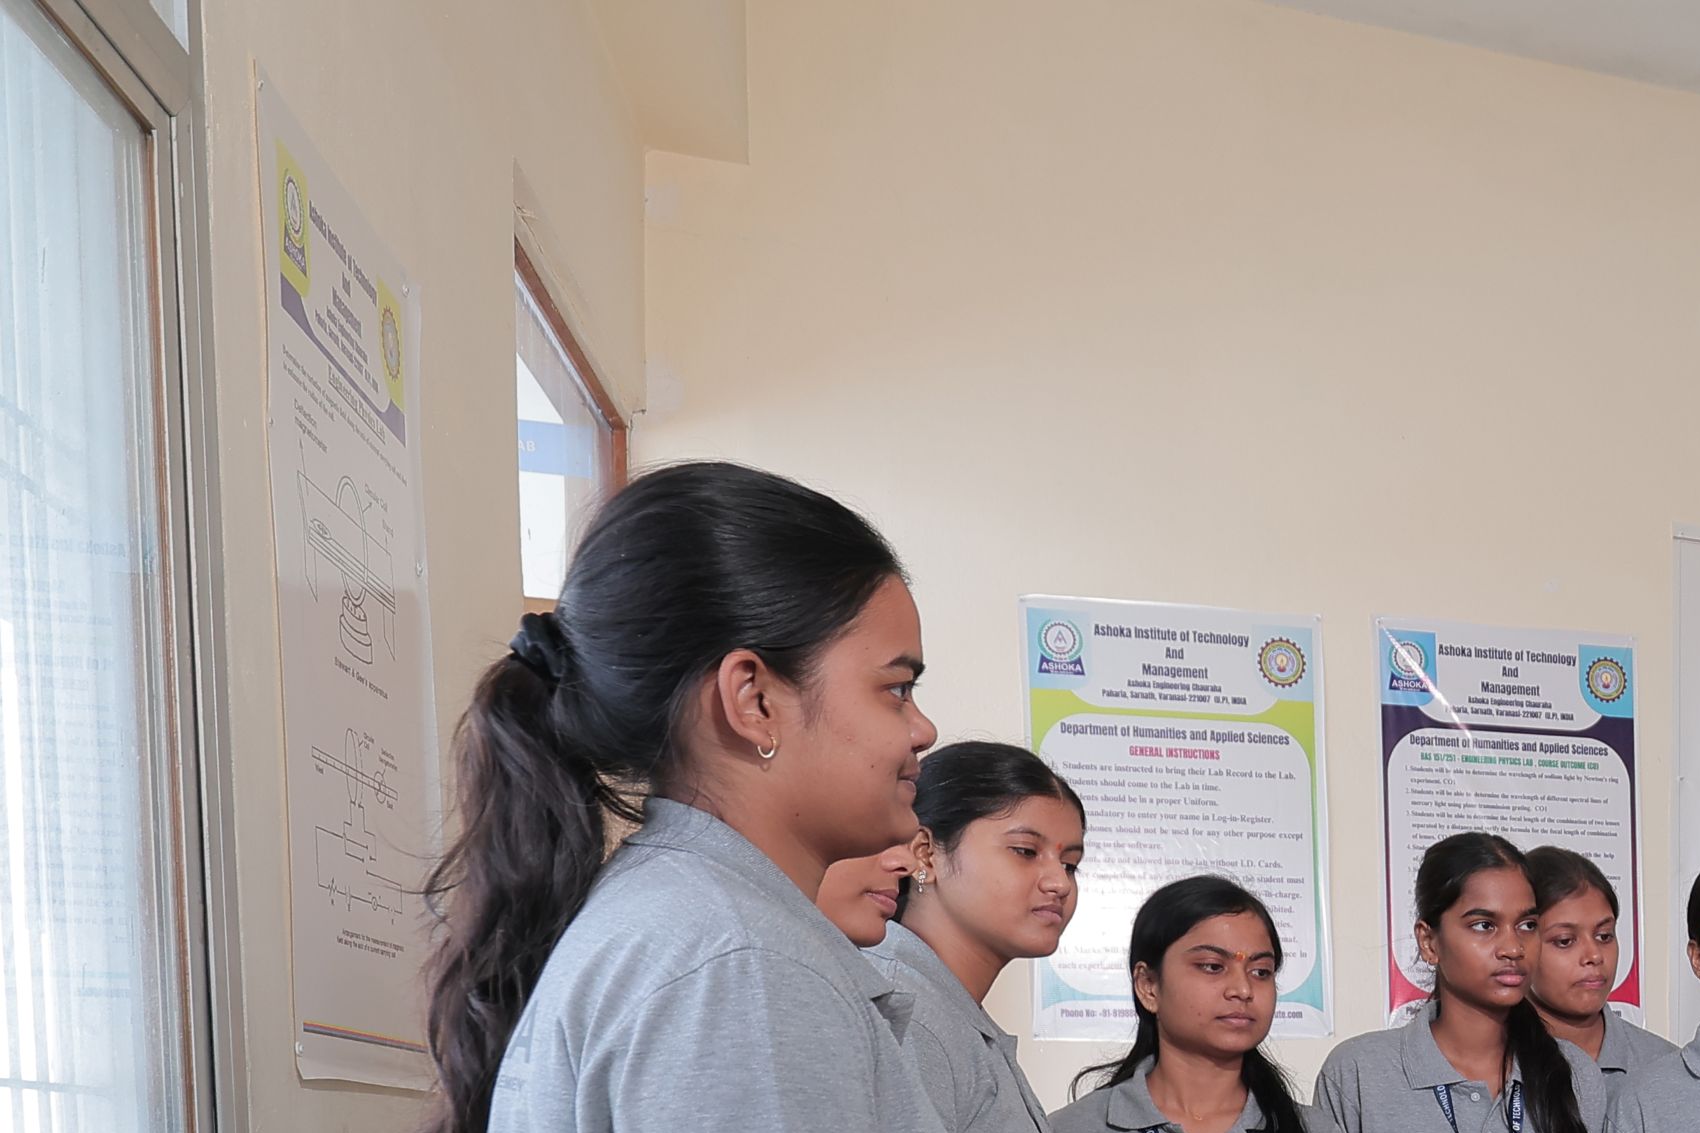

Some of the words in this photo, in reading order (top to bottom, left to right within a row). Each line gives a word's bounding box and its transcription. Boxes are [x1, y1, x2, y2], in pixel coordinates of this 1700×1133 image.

[1093, 623, 1132, 638] Ashoka
[1133, 626, 1177, 641] Institute
[1179, 629, 1190, 642] of
[1191, 630, 1249, 647] Technology
[1164, 646, 1184, 660] And
[1437, 643, 1472, 657] Ashoka
[1473, 646, 1512, 660] Institute
[1514, 649, 1524, 661] of
[1525, 650, 1577, 666] Technology
[1041, 661, 1082, 672] ASHOKA
[1141, 663, 1208, 679] Management
[1501, 665, 1519, 678] And
[1392, 679, 1428, 689] ASHOKA
[1480, 681, 1540, 698] Management
[1060, 721, 1118, 739] Department
[1120, 724, 1130, 737] of
[1132, 725, 1187, 740] Humanities
[1189, 727, 1207, 741] and
[1209, 728, 1245, 745] Applied
[1246, 730, 1290, 745] Sciences
[1410, 733, 1460, 750] Department
[1470, 736, 1520, 751] Humanities
[1521, 739, 1537, 752] and
[1538, 740, 1570, 756] Applied
[1570, 742, 1608, 756] Sciences
[1128, 745, 1164, 757] GENERAL
[1165, 747, 1220, 760] INSTRUCTIONS
[1062, 761, 1098, 771] Students
[1113, 763, 1154, 773] instructed
[1154, 765, 1164, 774] to
[1164, 765, 1186, 777] bring
[1187, 766, 1206, 775] their
[1207, 767, 1224, 776] Lab
[1225, 768, 1254, 777] Record
[1253, 769, 1263, 778] to
[1263, 769, 1277, 778] the
[1278, 770, 1296, 779] Lab.
[1064, 776, 1098, 786] tudents
[1099, 777, 1126, 787] should
[1149, 779, 1158, 789] to
[1159, 780, 1173, 789] the
[1174, 780, 1191, 790] Lab
[1191, 781, 1200, 790] in
[1201, 782, 1221, 791] time.
[1100, 793, 1126, 803] should
[1127, 794, 1138, 803] be
[1137, 794, 1147, 804] in
[1154, 797, 1183, 807] proper
[1182, 796, 1219, 806] Uniform.
[1126, 810, 1136, 819] to
[1137, 810, 1158, 820] enter
[1159, 813, 1177, 822] your
[1200, 812, 1210, 821] in
[1512, 1120, 1520, 1131] OF
